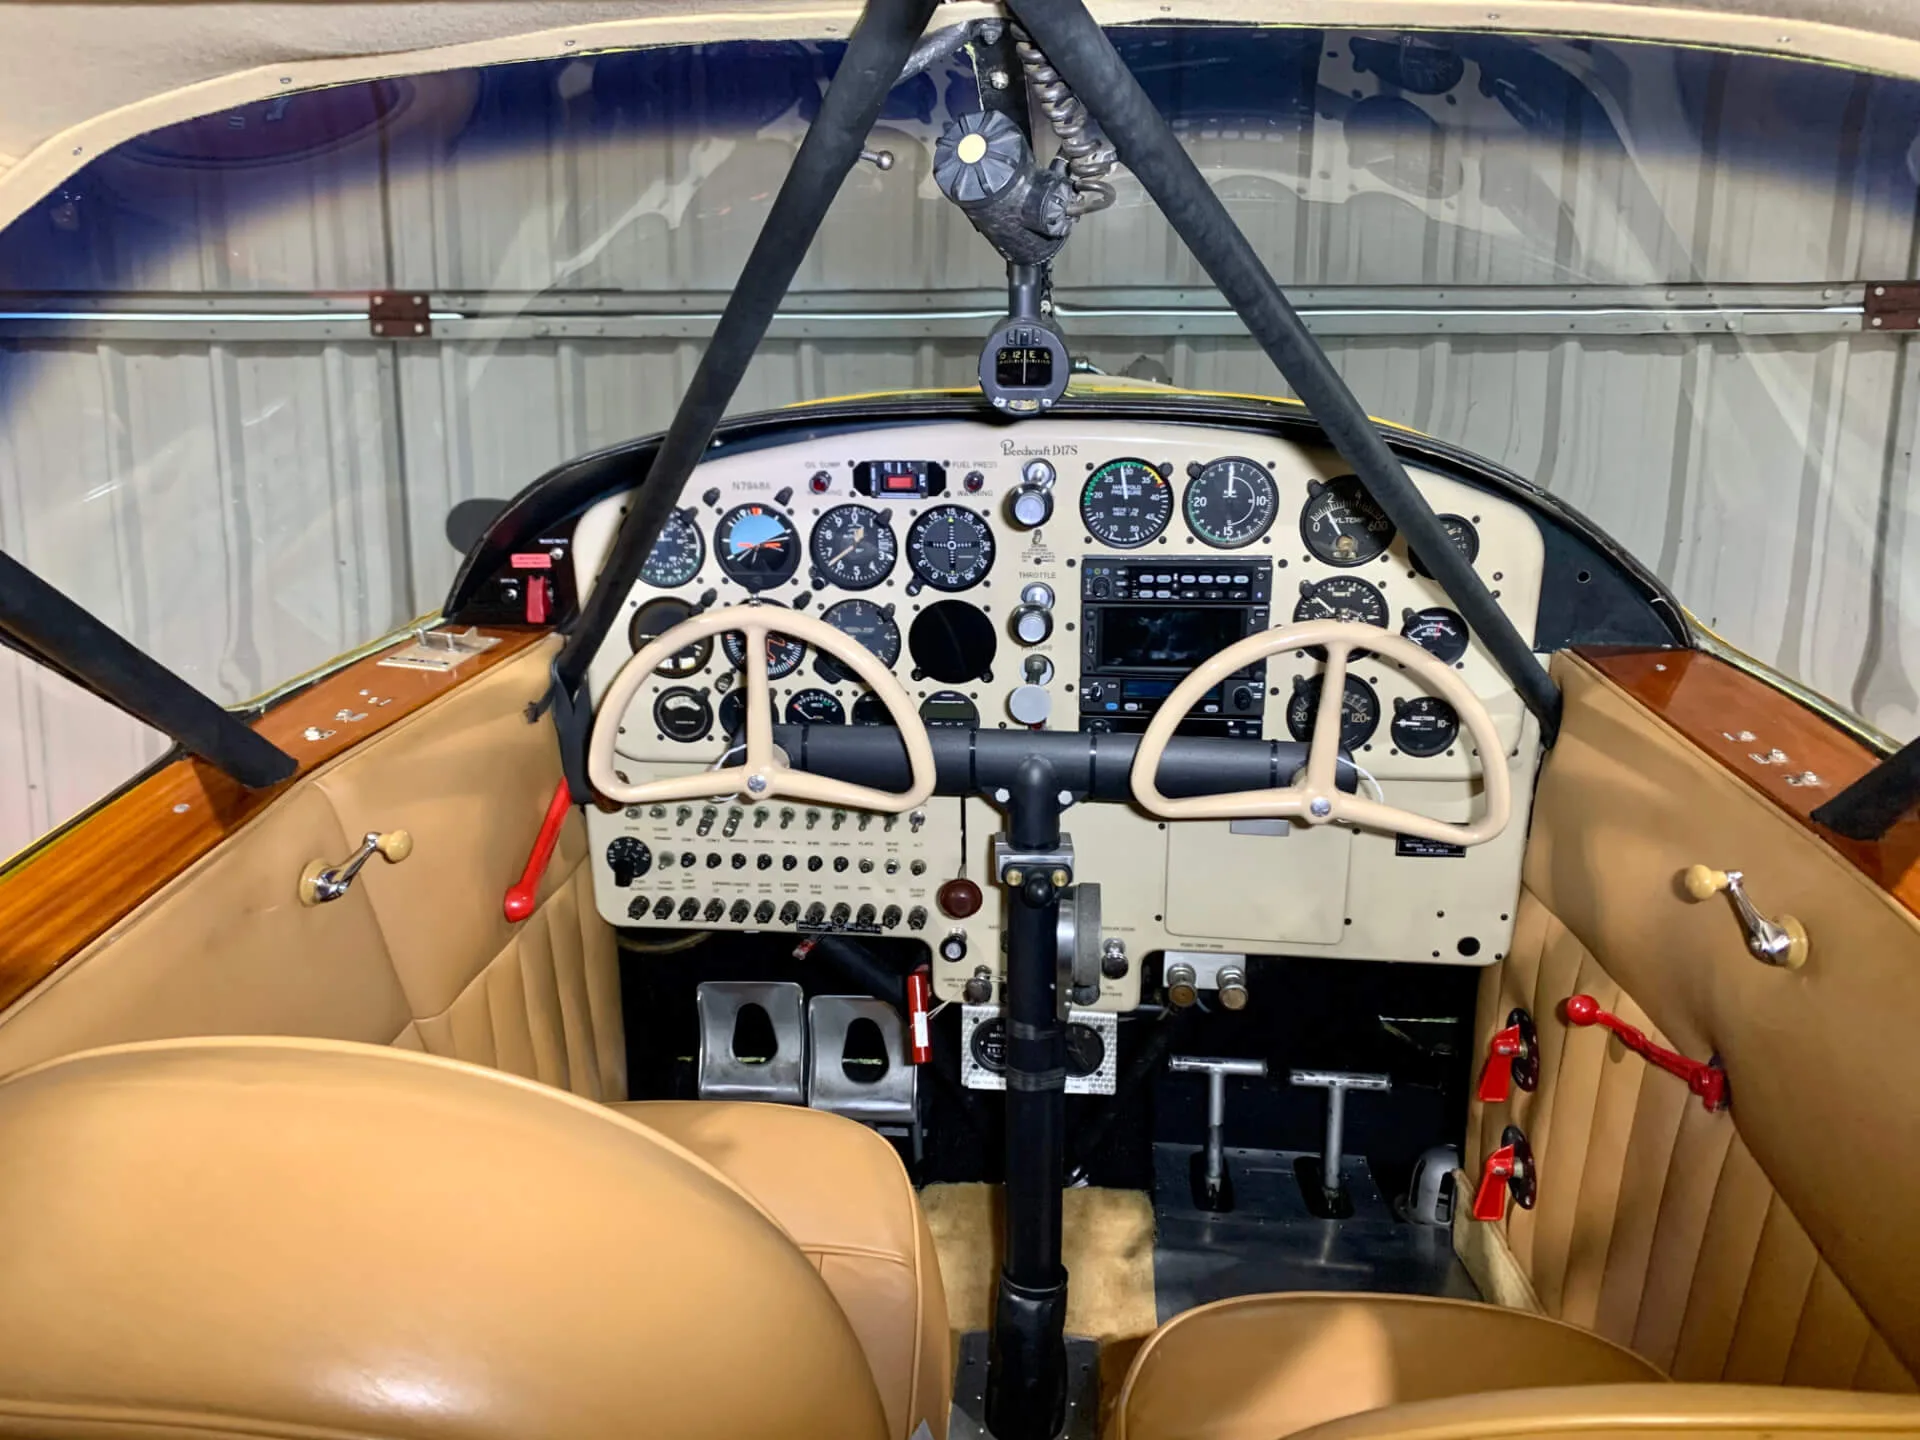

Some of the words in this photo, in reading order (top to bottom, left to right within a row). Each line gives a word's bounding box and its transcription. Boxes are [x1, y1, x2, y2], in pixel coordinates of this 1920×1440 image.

[1013, 350, 1021, 359] 12
[1029, 350, 1037, 359] E
[1000, 439, 1050, 457] Beechcraft
[1053, 445, 1078, 456] D17S
[1104, 475, 1114, 483] 25
[1141, 476, 1151, 484] 35
[1094, 491, 1103, 499] 20
[1327, 493, 1334, 503] 2
[1193, 496, 1207, 507] 20
[1255, 495, 1266, 506] 10
[851, 513, 858, 523] 0
[928, 511, 938, 520] 12
[1096, 511, 1104, 519] 15
[835, 517, 842, 528] 9
[1312, 522, 1320, 532] 0
[825, 530, 832, 540] 8
[877, 528, 884, 538] 2
[1223, 526, 1233, 536] 15
[826, 547, 832, 557] 7
[878, 551, 885, 560] 3
[837, 560, 844, 570] 6
[854, 566, 860, 576] 5
[1018, 571, 1057, 579] THROTTLE
[1421, 701, 1428, 711] 5
[1296, 711, 1308, 721] 20
[1351, 713, 1368, 723] 120
[1437, 720, 1446, 728] 10
